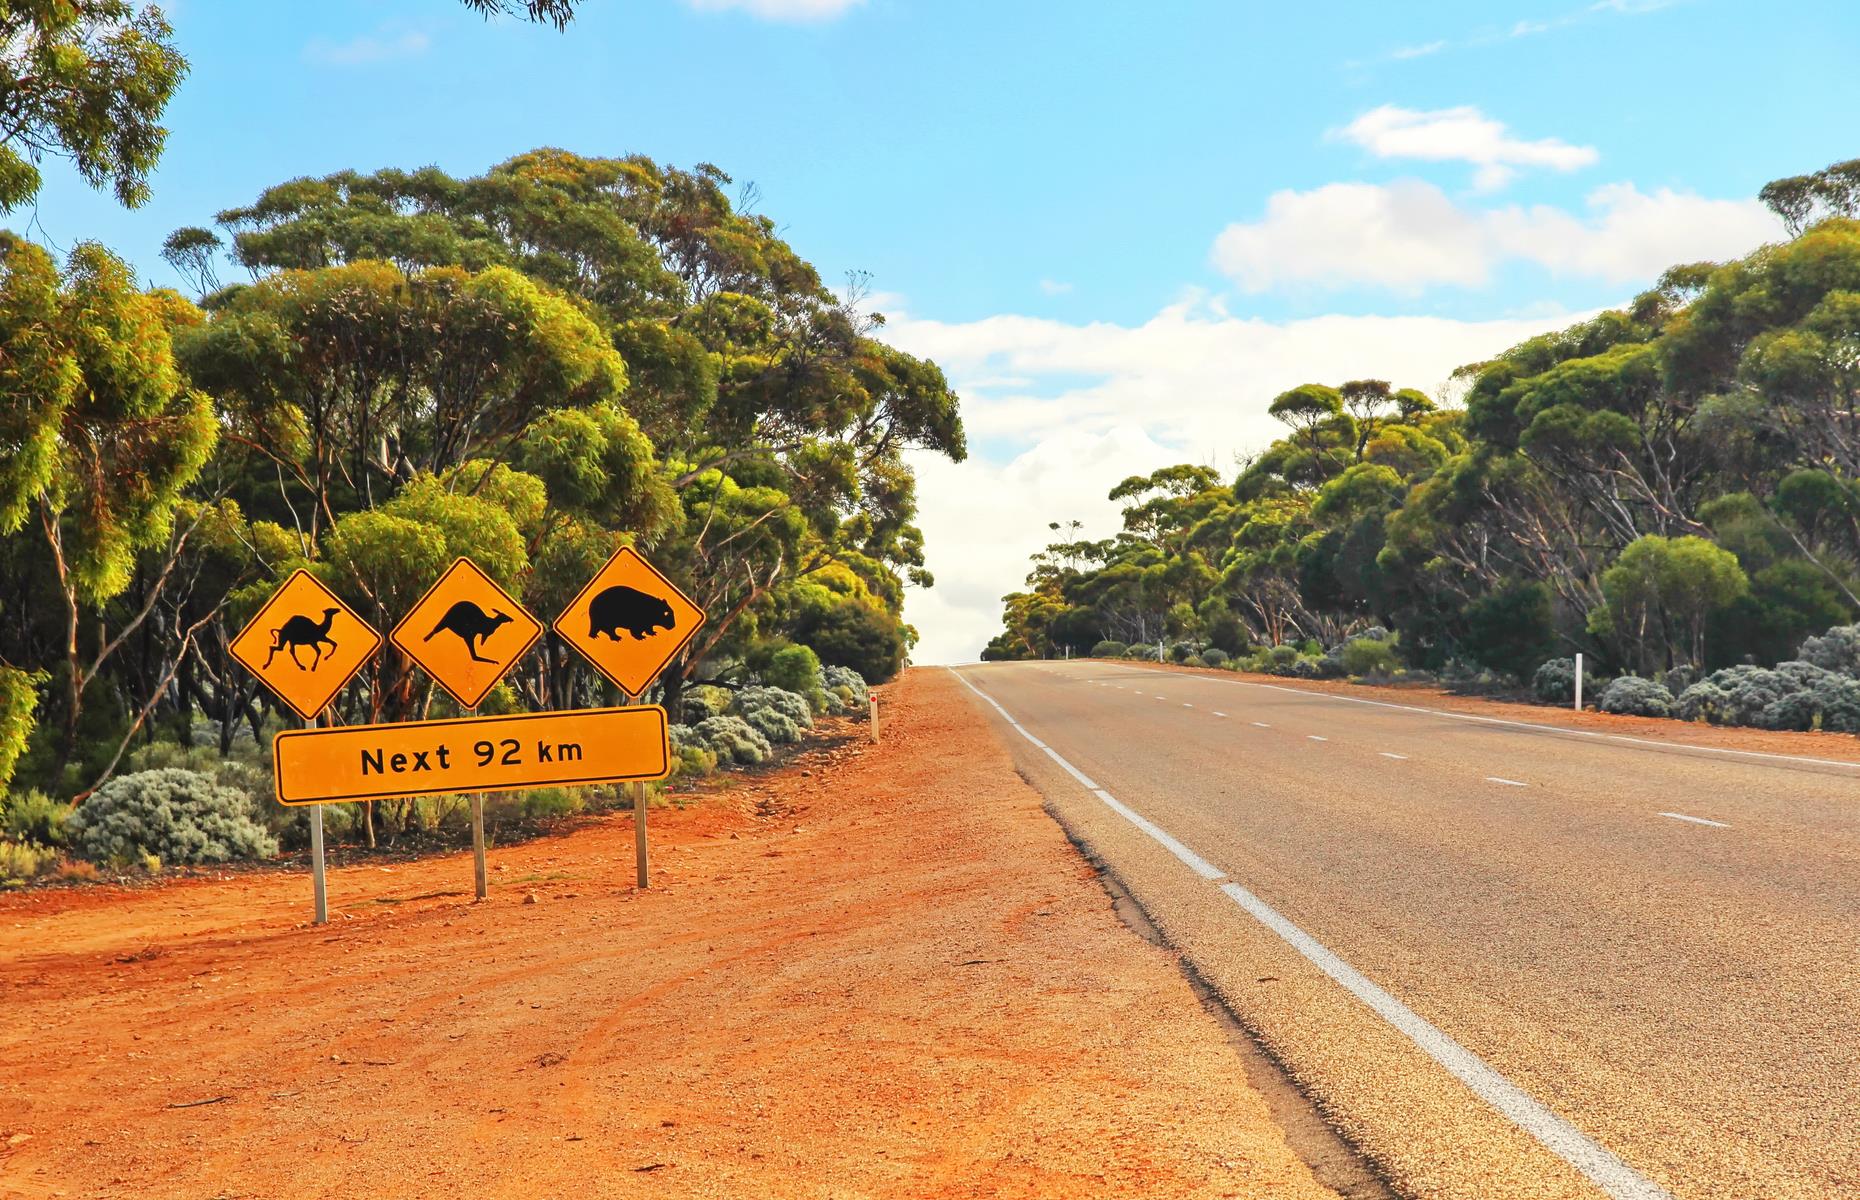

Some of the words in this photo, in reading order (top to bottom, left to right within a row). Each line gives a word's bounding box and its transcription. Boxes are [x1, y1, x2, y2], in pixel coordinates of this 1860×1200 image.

[361, 744, 451, 776] Next
[473, 739, 522, 767] 92
[537, 740, 583, 763] km
